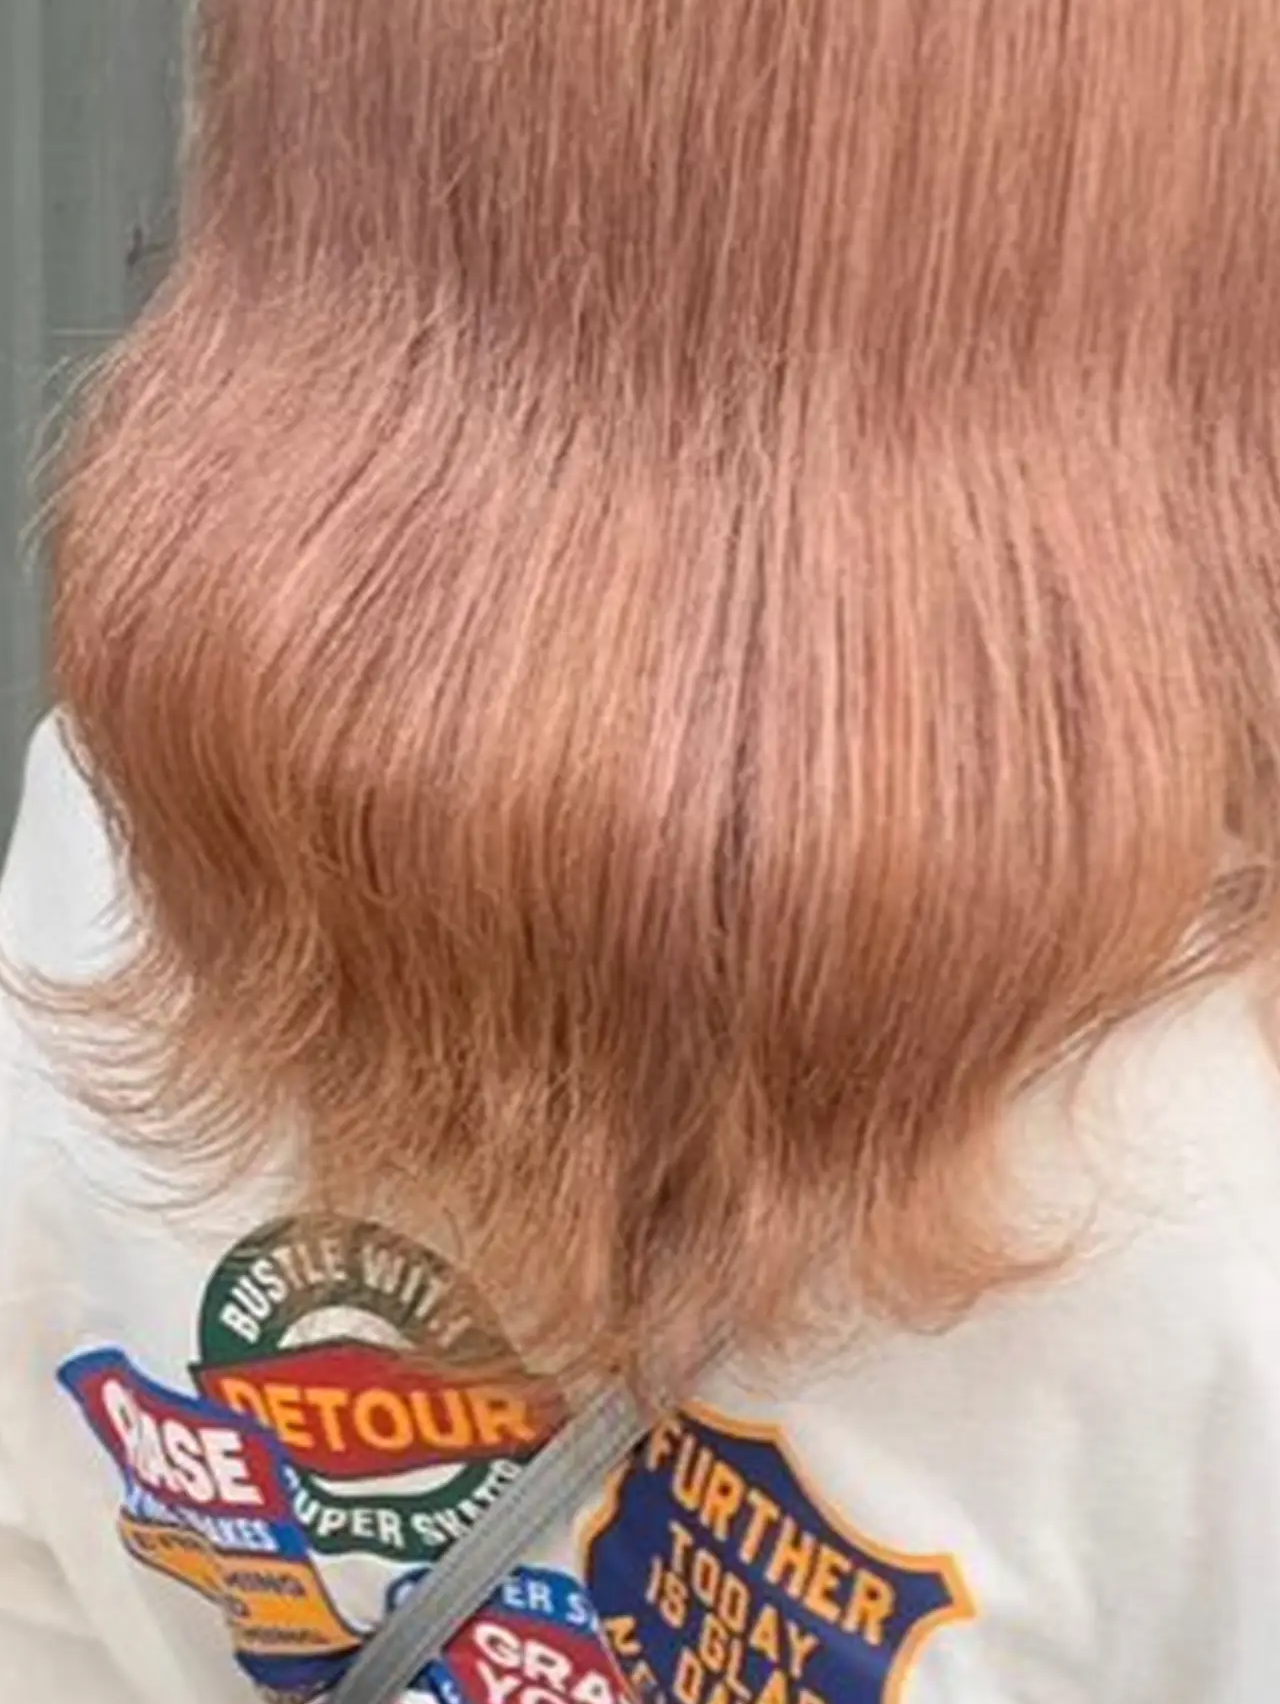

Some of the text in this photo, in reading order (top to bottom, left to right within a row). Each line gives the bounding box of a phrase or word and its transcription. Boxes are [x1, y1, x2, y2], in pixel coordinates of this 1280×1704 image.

[220, 1240, 347, 1344] BUSTLE
[220, 1377, 537, 1452] DETOUR
[646, 1417, 897, 1645] FURTHER
[669, 1520, 819, 1679] TODAY
